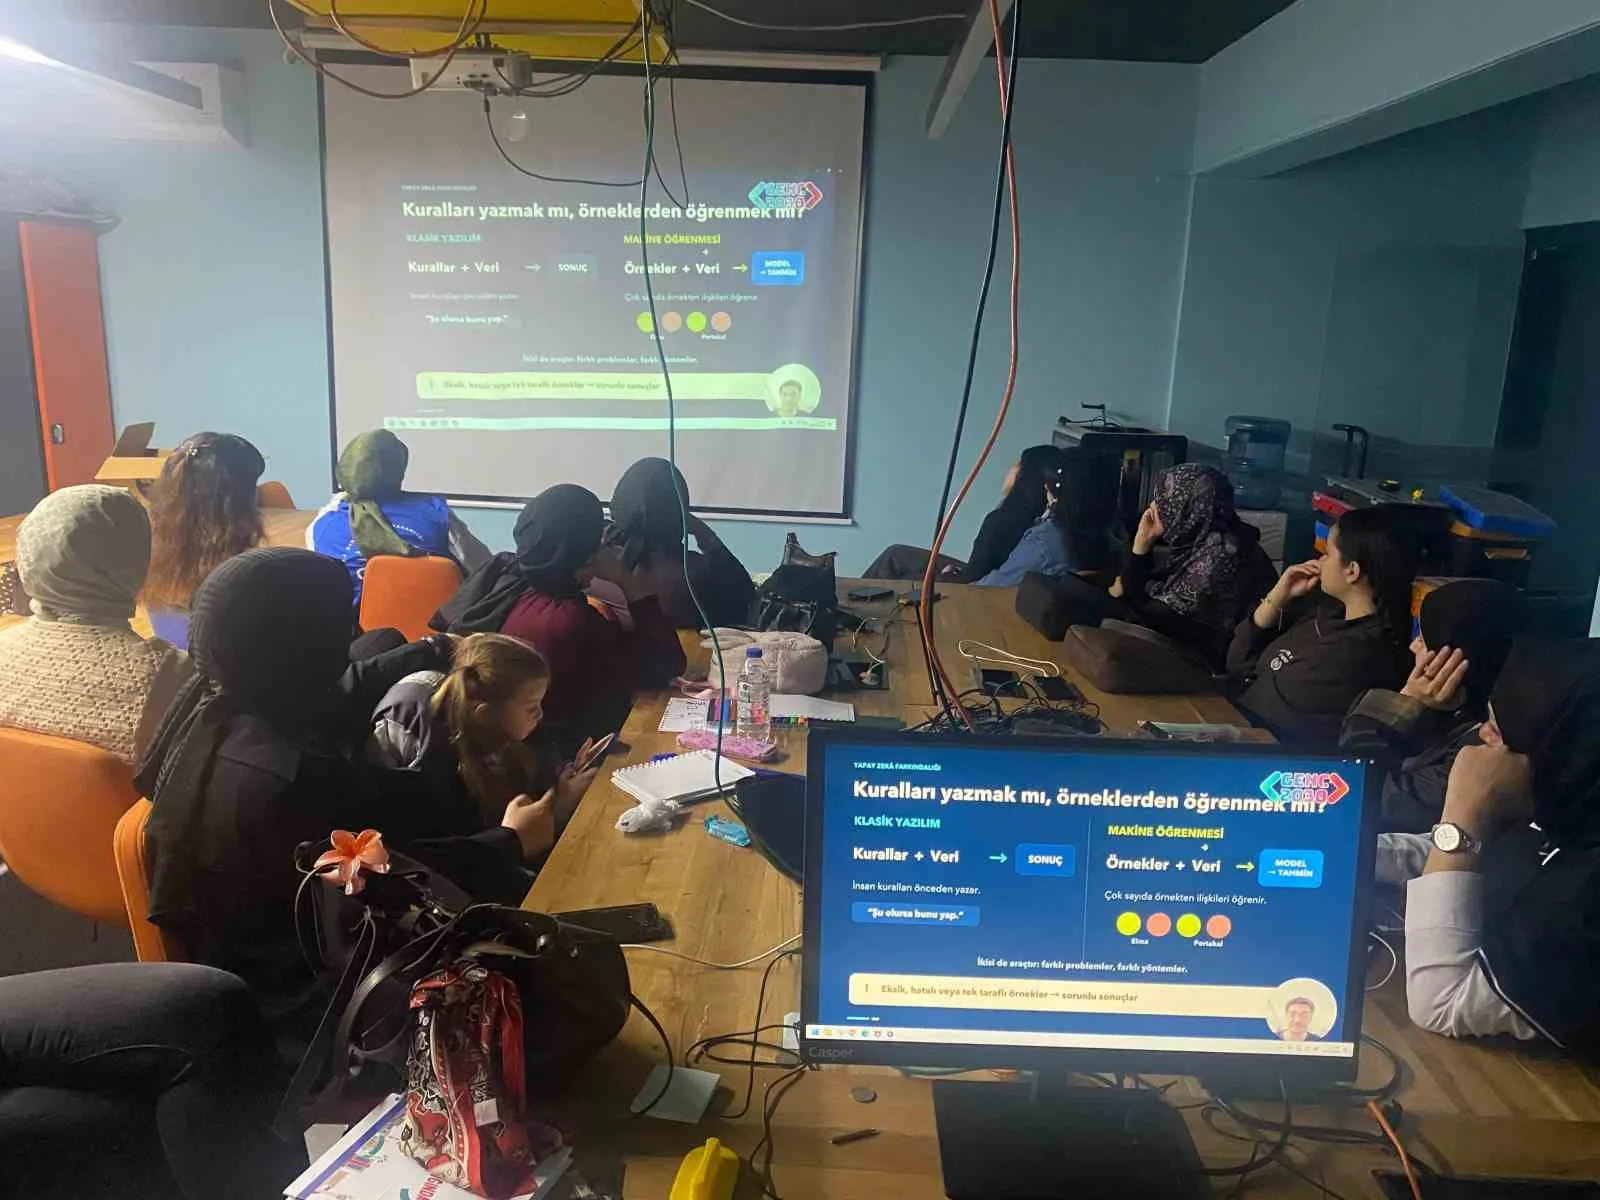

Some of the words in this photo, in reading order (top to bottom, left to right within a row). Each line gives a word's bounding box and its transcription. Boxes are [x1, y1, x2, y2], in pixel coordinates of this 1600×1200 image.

[402, 202, 475, 217] Kuralları
[478, 203, 544, 220] yazmak
[548, 206, 574, 220] mı,
[578, 203, 682, 219] örneklerden
[686, 203, 771, 222] öğrenmek
[408, 261, 456, 273] Kurallar
[474, 262, 500, 273] Veri
[557, 263, 589, 274] SONUÇ
[695, 263, 720, 274] Veri
[853, 780, 937, 800] Kuralları
[940, 785, 1017, 805] yazmak
[1021, 791, 1051, 806] mı,
[1056, 788, 1179, 809] örneklerden
[1184, 792, 1286, 814] öğrenmek
[853, 814, 893, 827] KLASİK
[895, 817, 941, 829] YAZILIM
[1107, 824, 1154, 837] MAKİNE
[1155, 825, 1224, 839] ÖĞRENMESİ
[853, 847, 908, 862] Kurallar
[914, 852, 924, 862] +
[930, 850, 960, 864] Veri
[1027, 854, 1063, 867] SONUÇ
[1274, 858, 1307, 868] MODEL
[1105, 854, 1170, 871] Örnekler
[1175, 861, 1185, 871] +
[1191, 859, 1221, 873] Veri
[852, 879, 876, 891] İnsan
[877, 880, 913, 893] kuralları
[914, 882, 954, 894] önceden
[954, 885, 981, 896] yazar.
[1104, 890, 1123, 903] Çok
[1124, 891, 1153, 904] sayıda
[1154, 892, 1195, 903] örnekten
[1196, 893, 1230, 905] ilişkileri
[1231, 894, 1267, 906] öğrenir.
[884, 908, 913, 919] olursa
[914, 908, 938, 919] bunu
[1193, 939, 1223, 948] Portakal
[977, 955, 995, 967] İkisi
[996, 958, 1009, 967] de
[1041, 958, 1064, 970] farklı
[1065, 959, 1116, 974] problemler,
[1117, 961, 1140, 972] farklı
[1141, 963, 1188, 975] yöntemler.
[881, 984, 907, 996] Eksik,
[910, 985, 937, 996] hatalı
[938, 988, 961, 998] veya
[962, 987, 978, 997] tek
[979, 988, 1007, 998] taraflı
[1008, 989, 1049, 999] örnekler
[1061, 990, 1097, 1001] sorunlu
[1098, 992, 1139, 1003] sonuçlar
